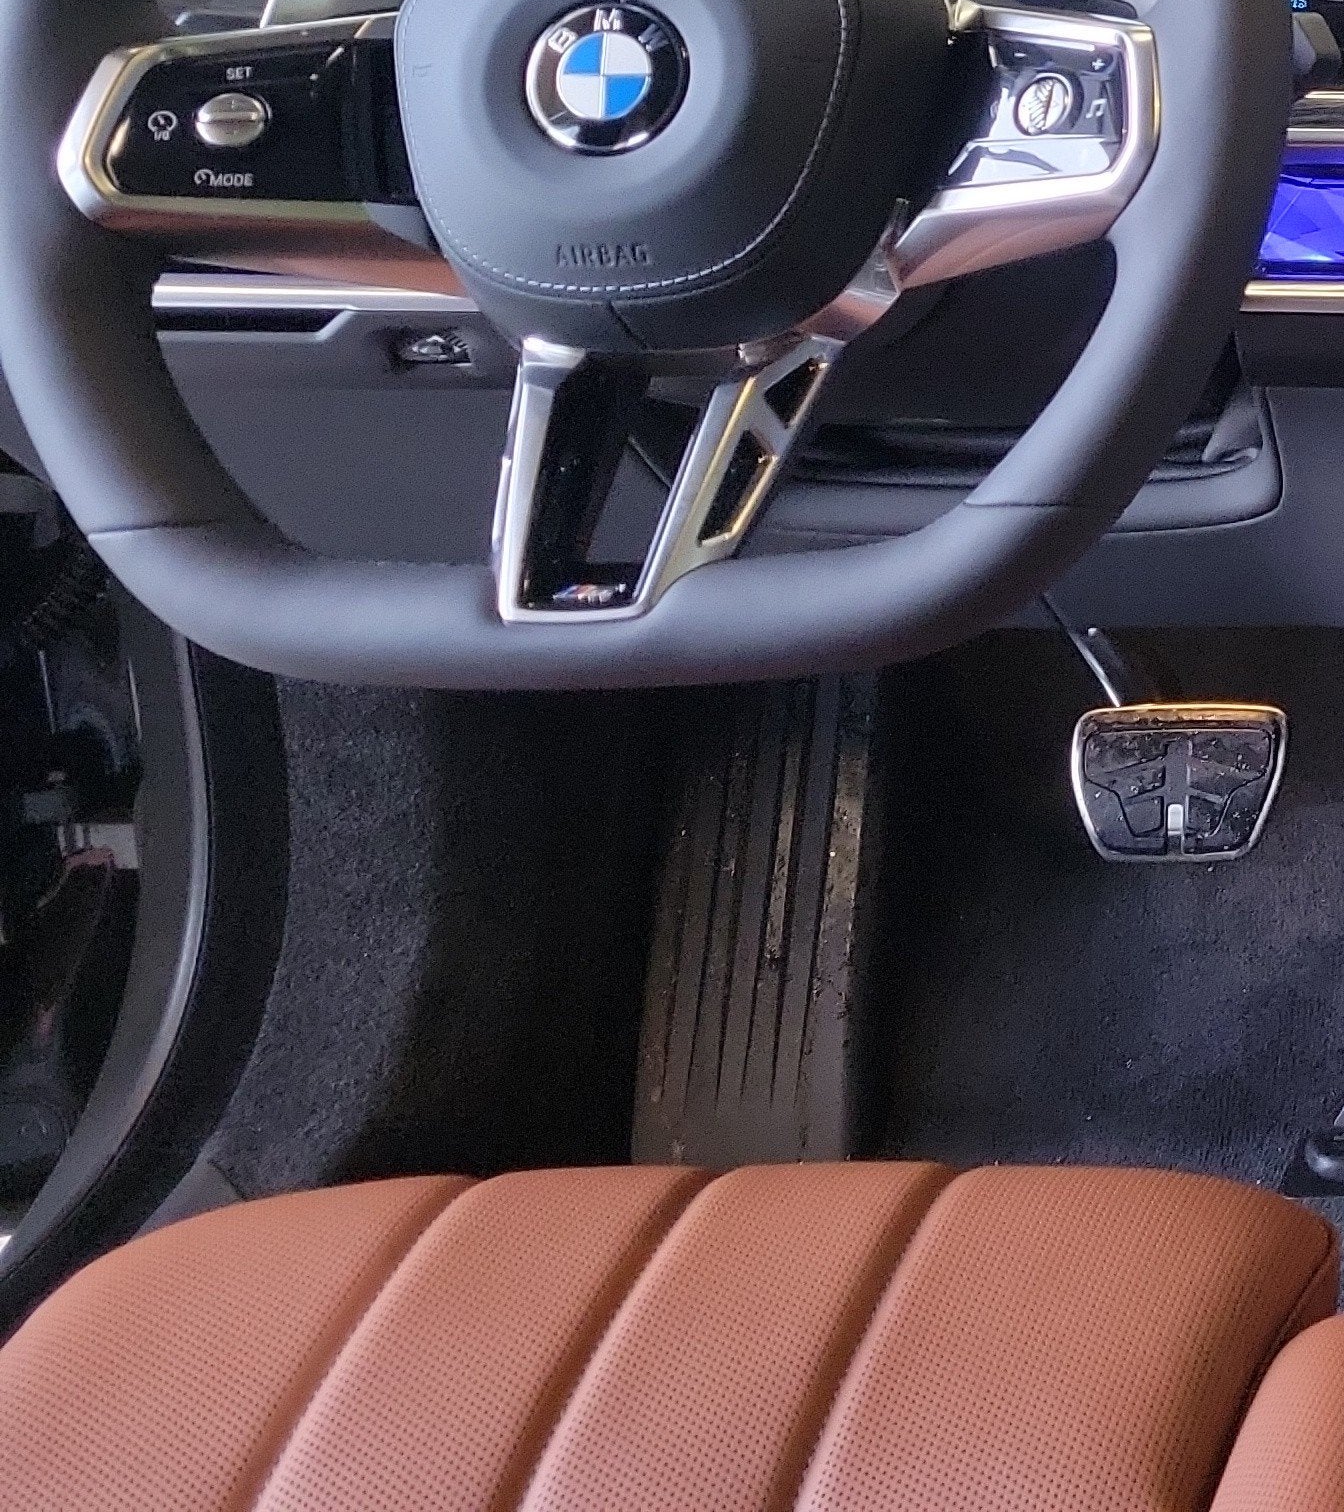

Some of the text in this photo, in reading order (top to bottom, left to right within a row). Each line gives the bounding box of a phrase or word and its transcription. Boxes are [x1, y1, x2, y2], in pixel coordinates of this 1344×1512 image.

[547, 7, 671, 53] BMW
[226, 66, 253, 80] SET
[210, 173, 253, 187] MODE
[555, 243, 650, 267] AIRBAG
